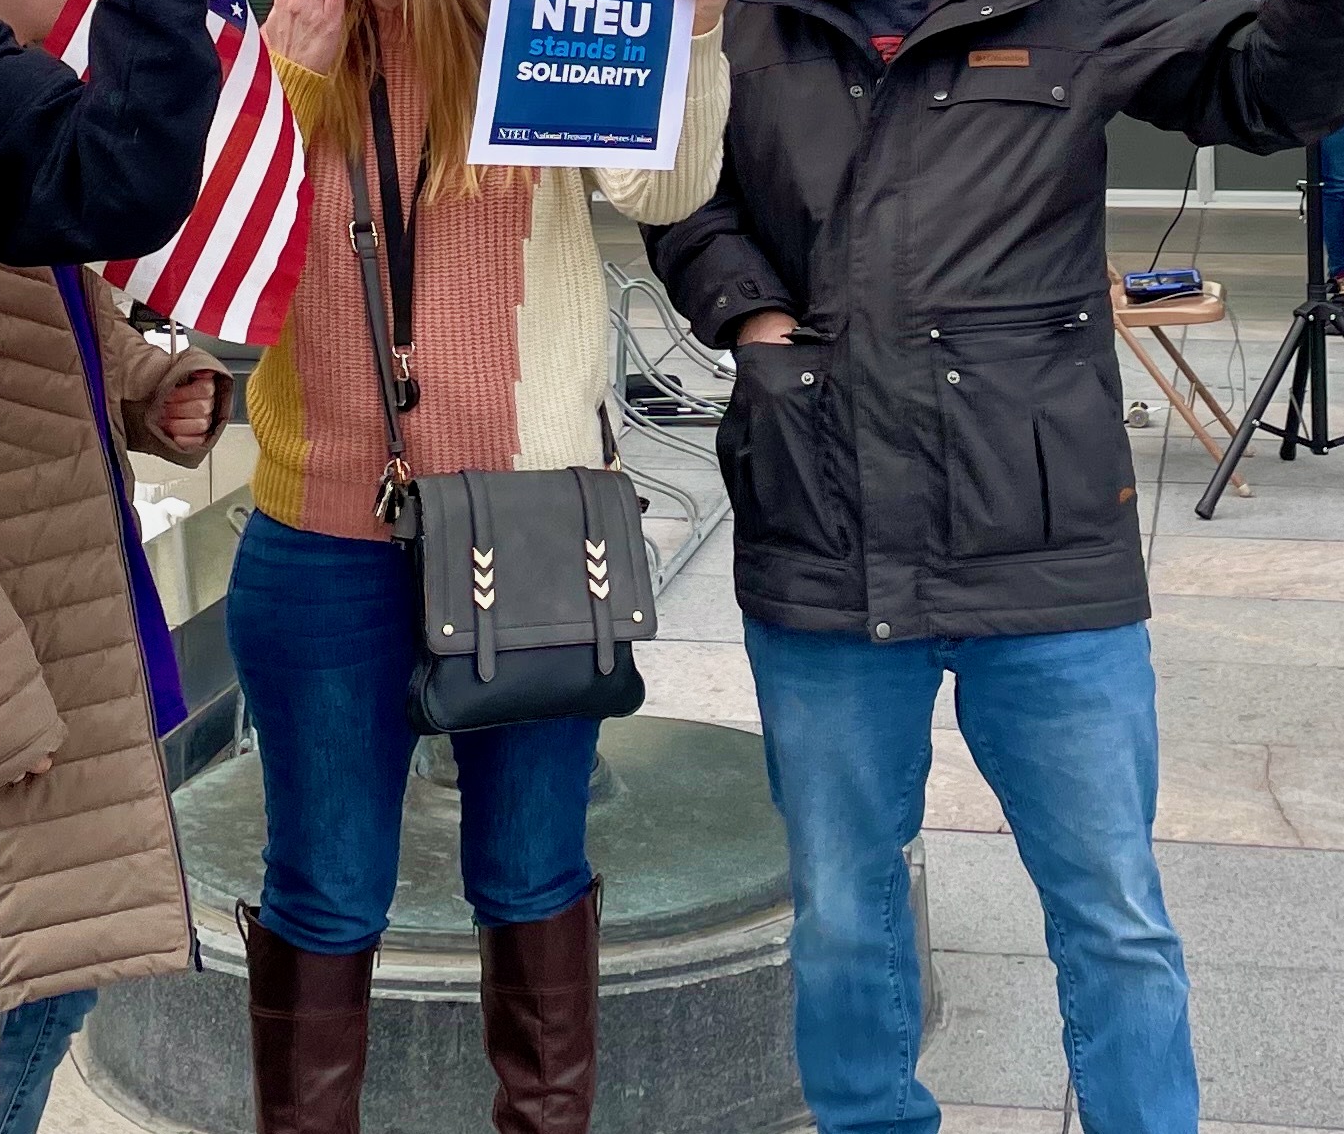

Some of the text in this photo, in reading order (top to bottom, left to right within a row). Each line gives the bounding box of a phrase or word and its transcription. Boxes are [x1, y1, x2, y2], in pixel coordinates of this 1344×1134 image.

[528, 35, 646, 62] stands in
[516, 61, 651, 87] SOLIDARITY
[497, 127, 531, 141] NTEU
[533, 130, 562, 140] National
